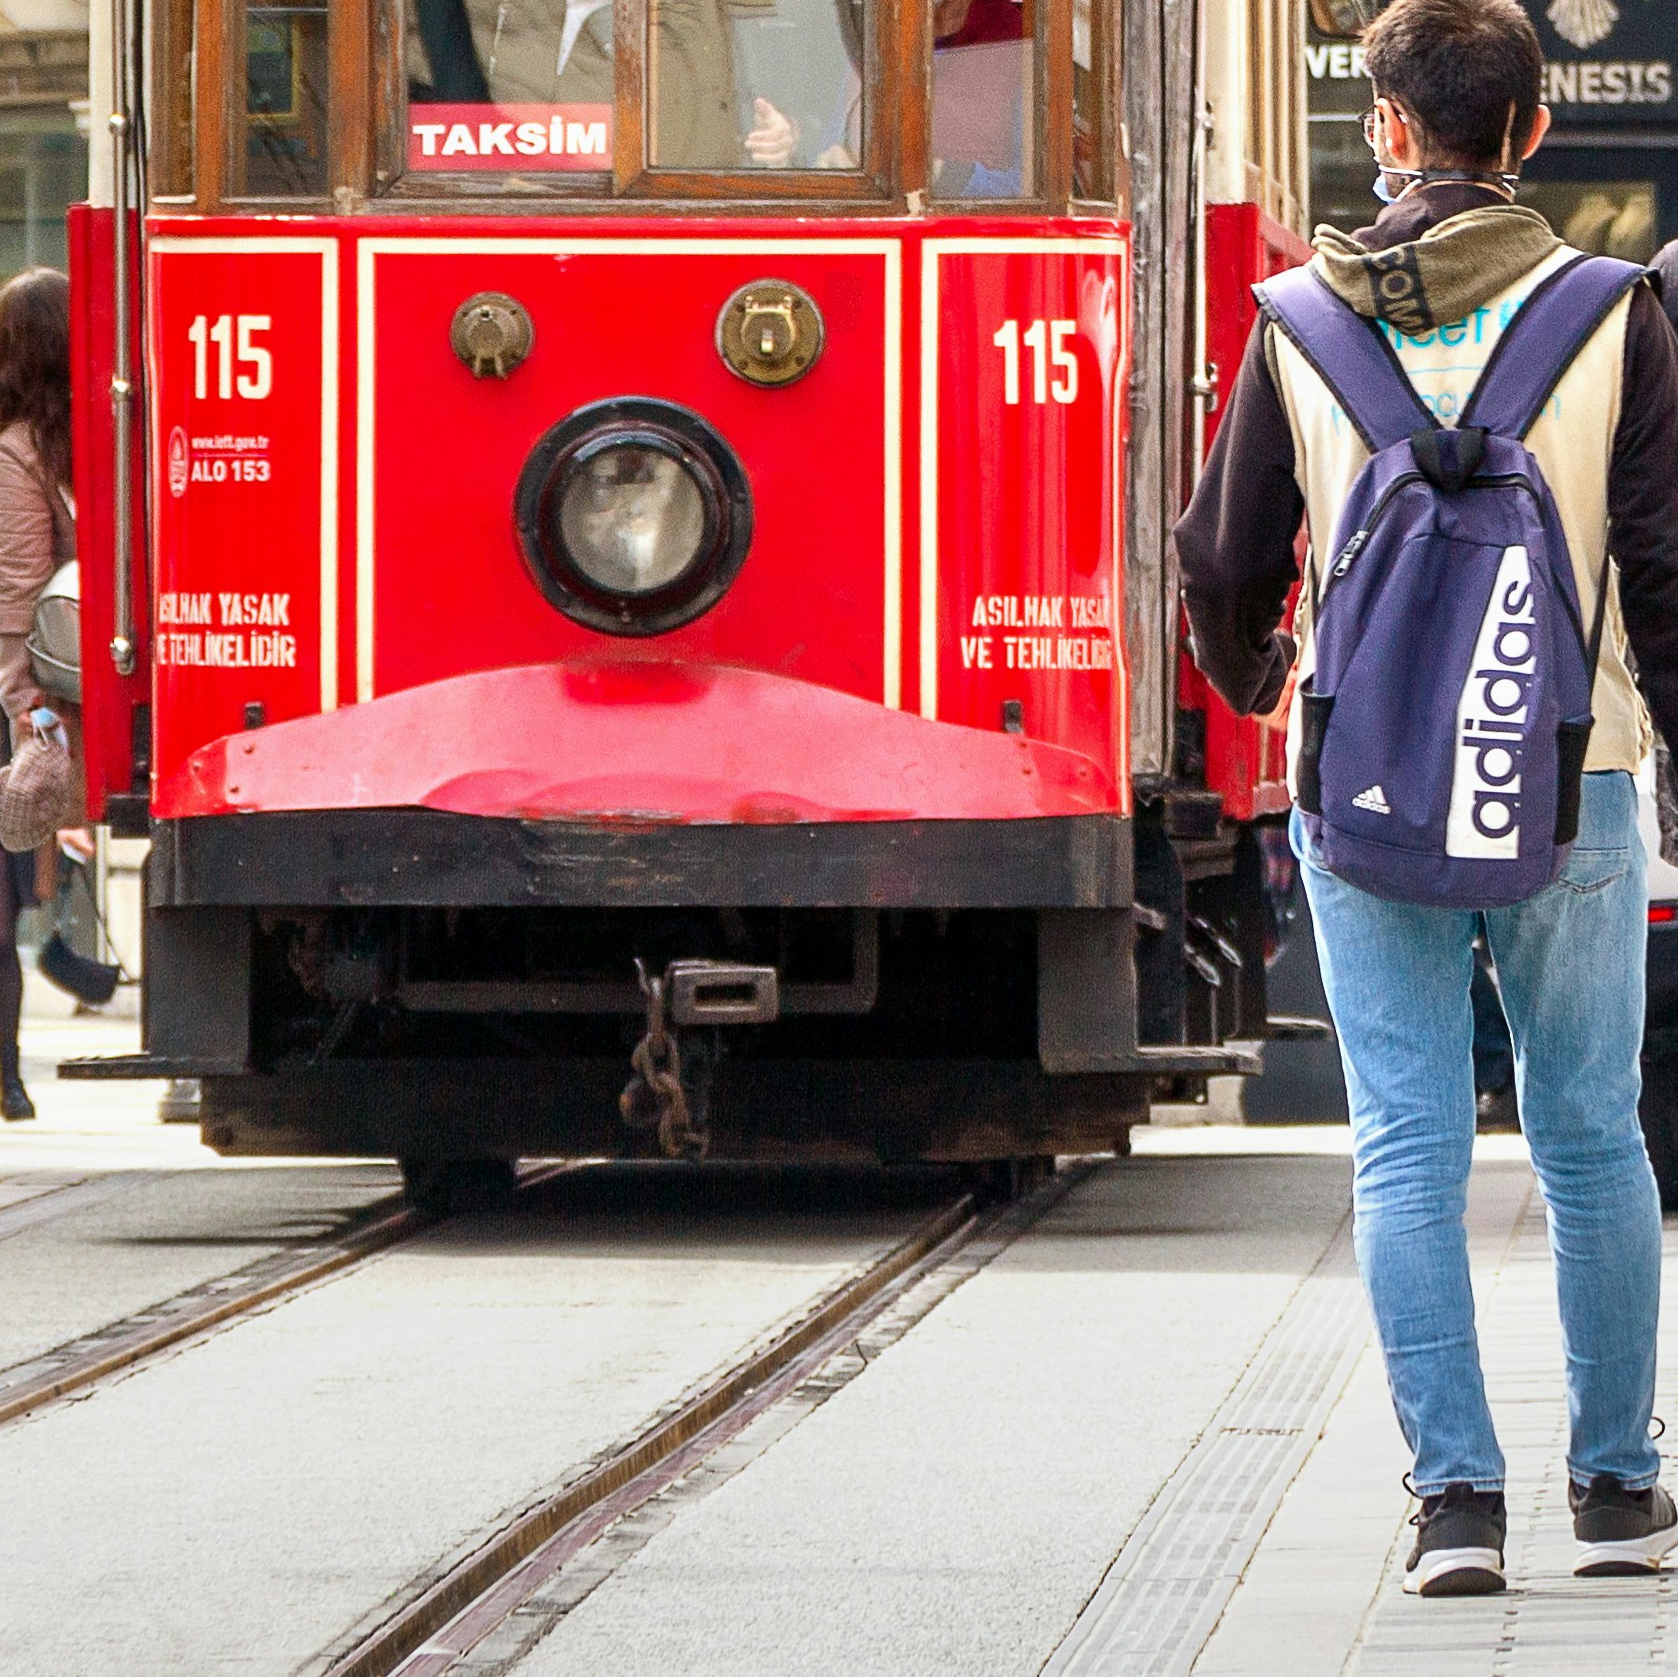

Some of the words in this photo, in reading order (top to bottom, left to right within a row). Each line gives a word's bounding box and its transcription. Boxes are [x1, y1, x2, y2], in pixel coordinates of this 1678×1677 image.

[1306, 45, 1372, 79] VER
[411, 114, 607, 156] TAKSİM
[187, 314, 273, 400] 115
[993, 319, 1079, 405] 115
[190, 459, 227, 482] ALO
[231, 459, 271, 482] 153
[218, 592, 291, 627] YASAK
[960, 635, 994, 670] VE
[1463, 580, 1537, 840] adidas
